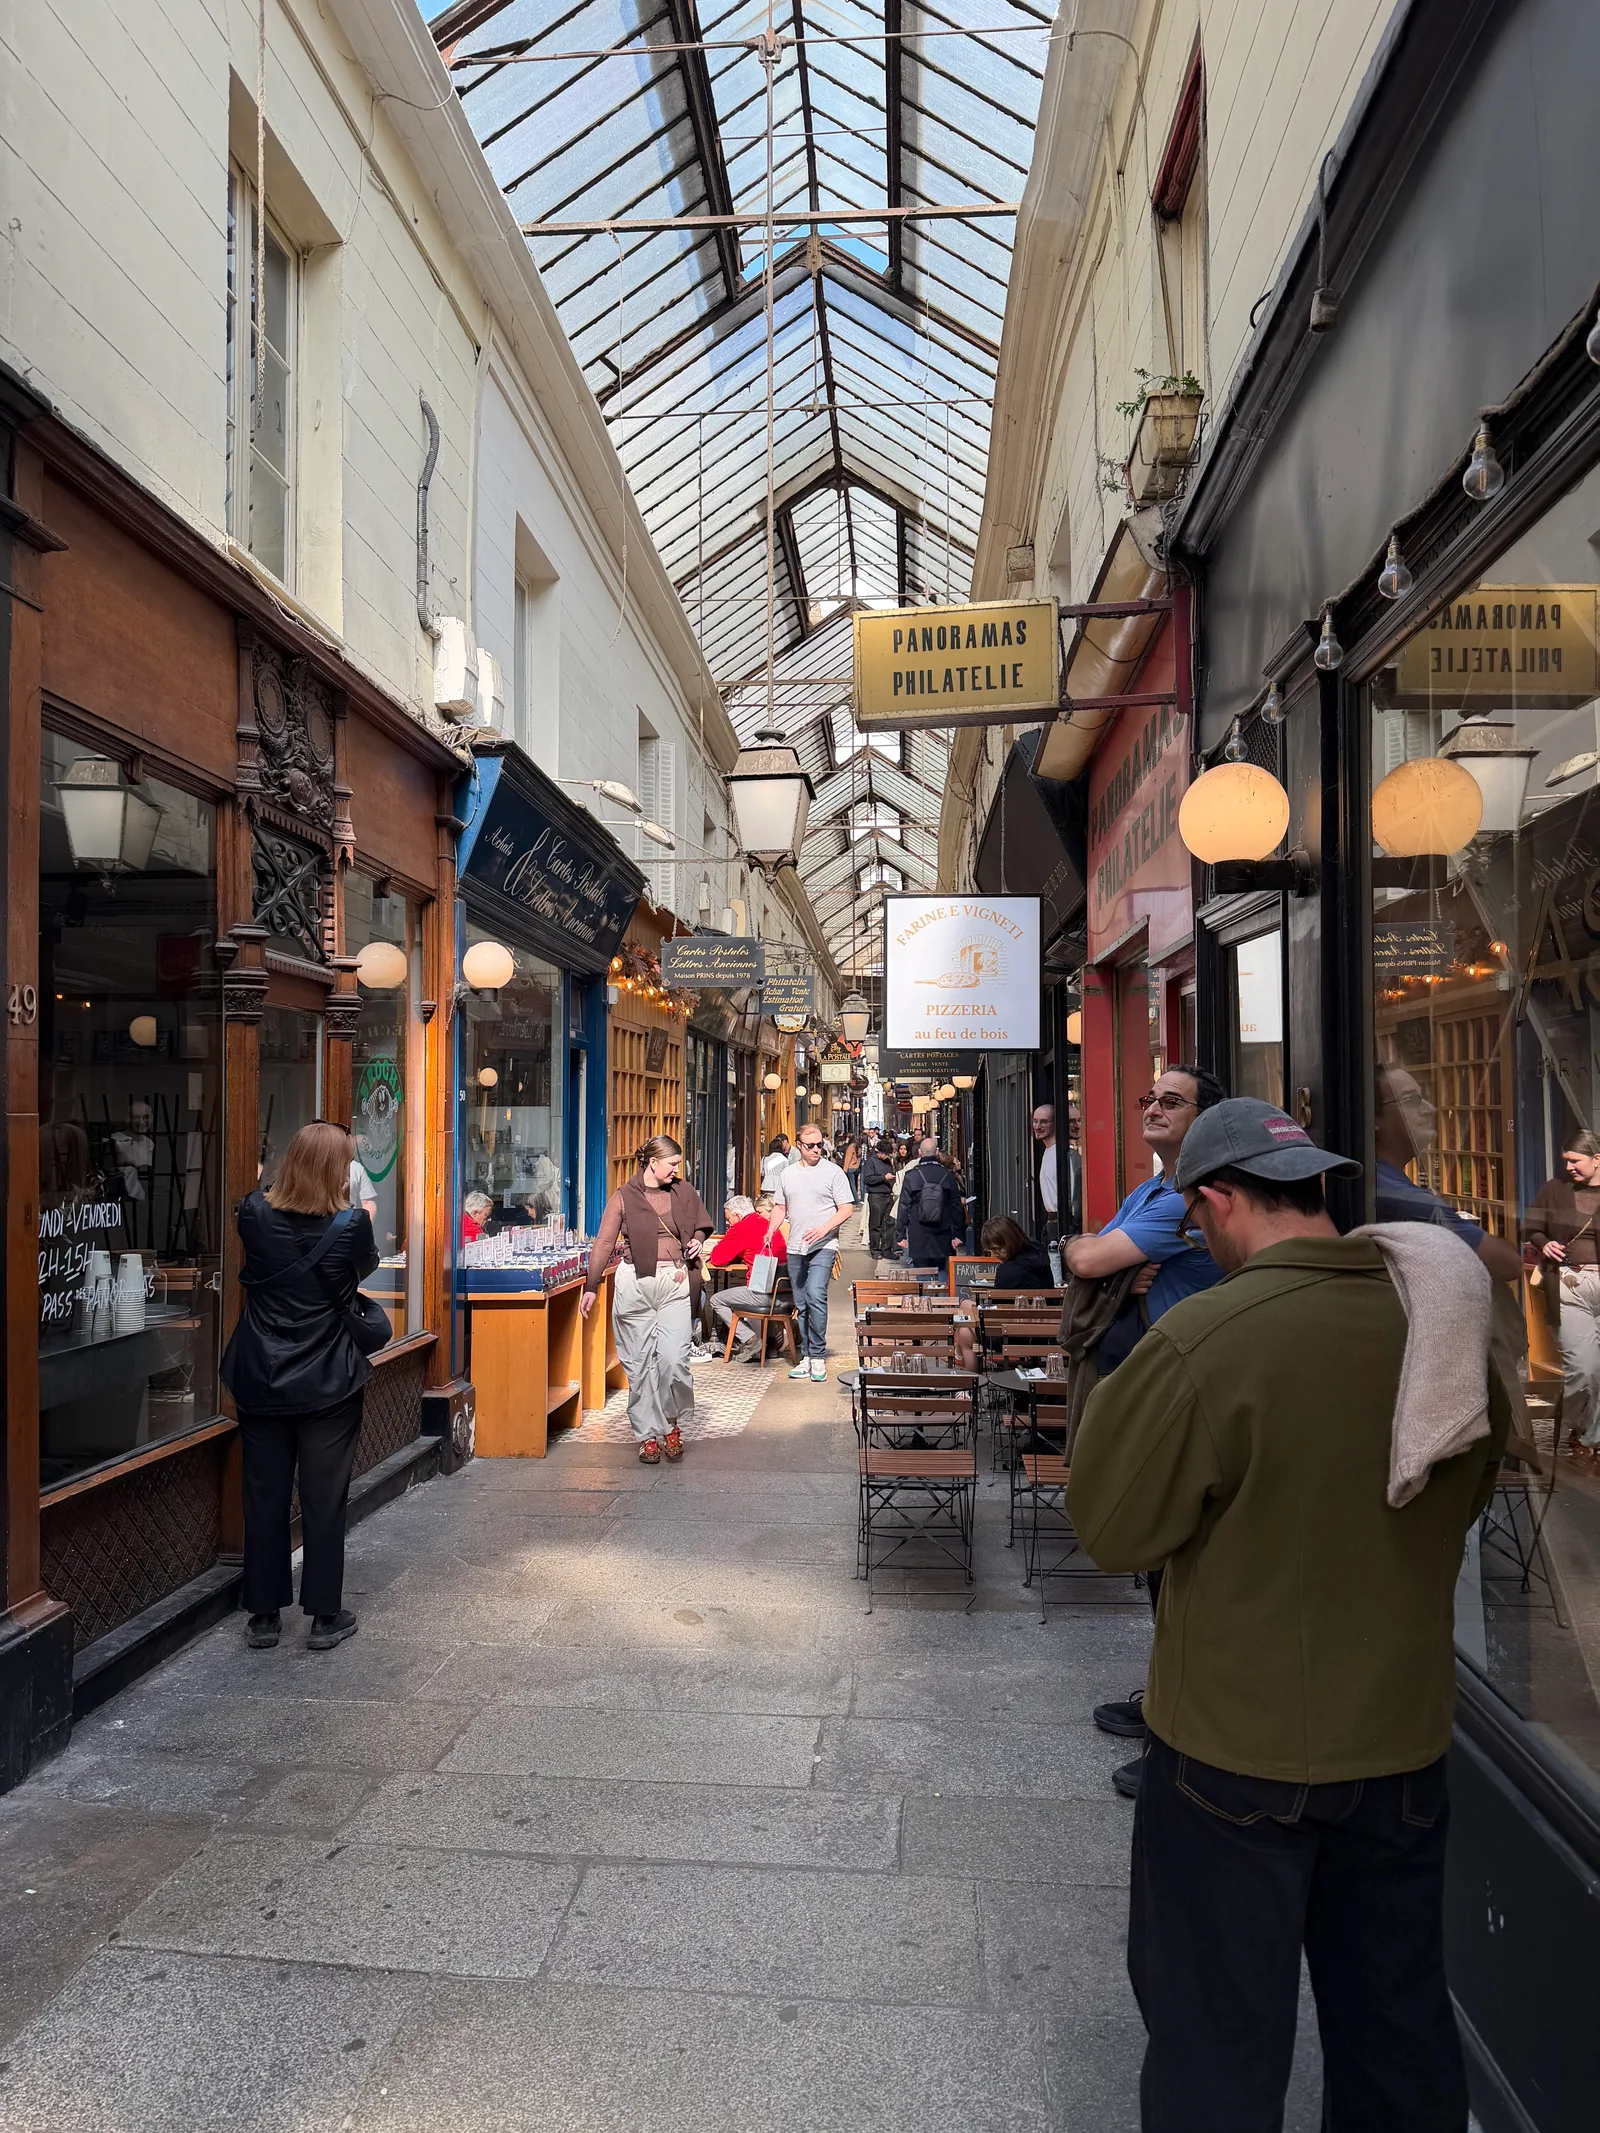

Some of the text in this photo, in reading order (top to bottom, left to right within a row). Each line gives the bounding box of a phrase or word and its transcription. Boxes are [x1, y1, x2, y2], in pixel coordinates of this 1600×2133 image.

[893, 619, 1027, 653] PANORAMAS
[893, 663, 1023, 696] PHILATELIE
[1091, 683, 1185, 852] PANORAMAS
[484, 825, 514, 857] Achats
[1097, 771, 1177, 910] PHILATELIE
[545, 835, 611, 908] Cartes Postales
[519, 870, 598, 944] Lettres Anciennes
[896, 904, 1025, 946] FARINE E VIGNETI
[676, 944, 750, 956] Cartes Postales
[668, 956, 757, 969] Lettres Anciennes
[715, 972, 734, 980] depuis
[766, 978, 808, 986] Philatelie
[763, 987, 811, 995] Achat Vente
[7, 984, 37, 1025] 49
[762, 996, 804, 1004] Estimation
[778, 1004, 811, 1012] Gratuite
[925, 1004, 998, 1016] PIZZERIA
[914, 1027, 1008, 1040] au feu de bois
[459, 1090, 466, 1102] 50
